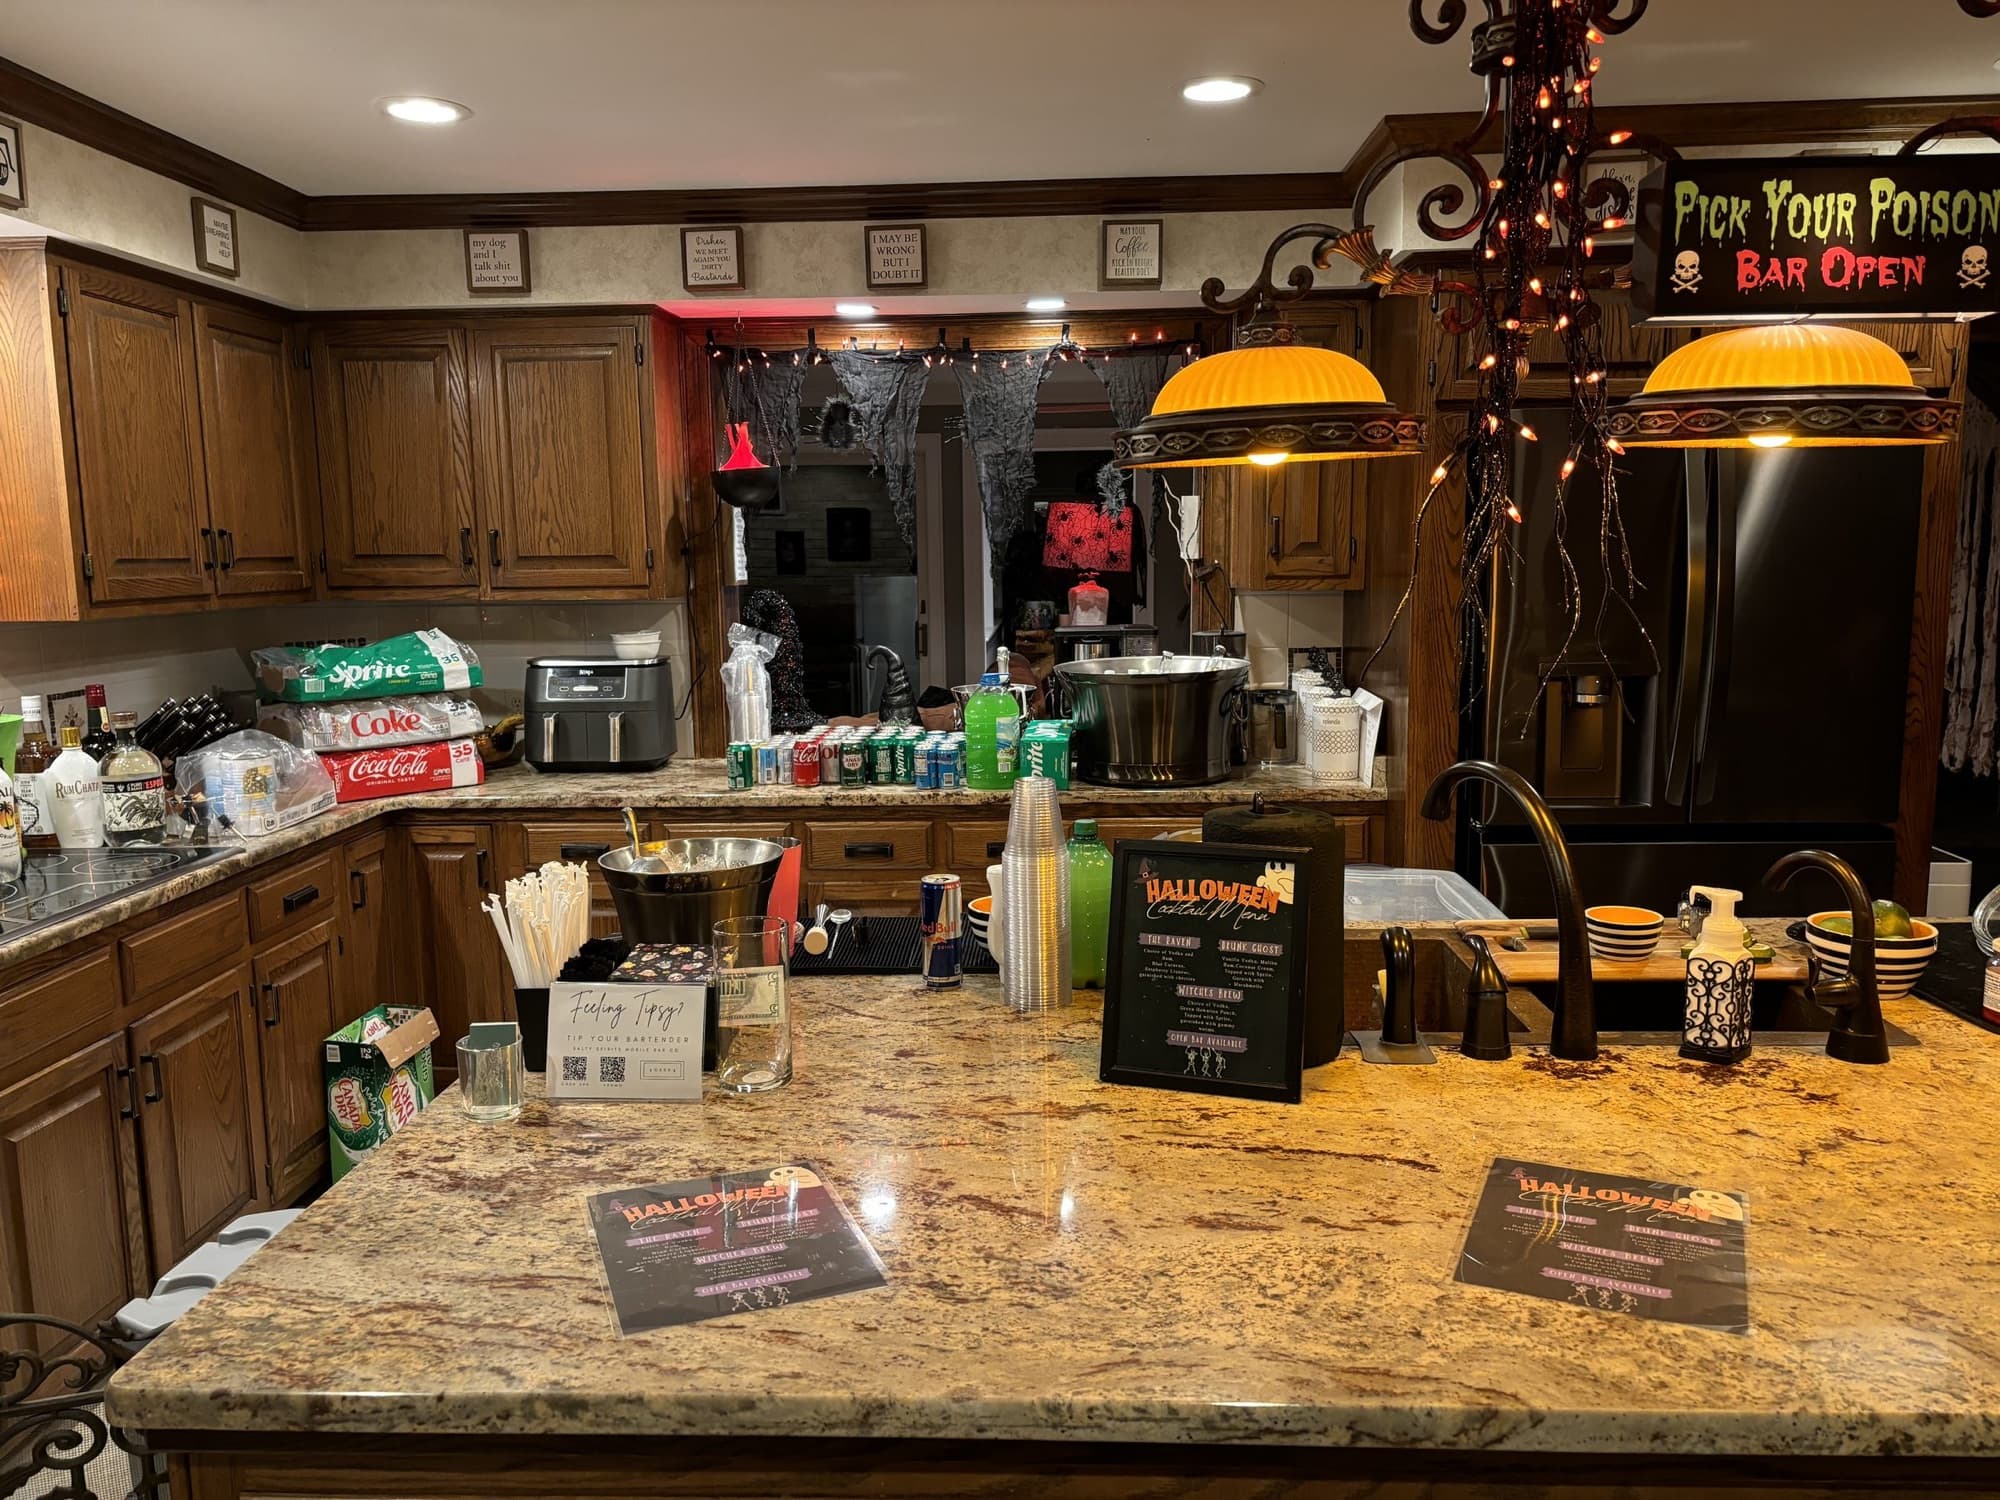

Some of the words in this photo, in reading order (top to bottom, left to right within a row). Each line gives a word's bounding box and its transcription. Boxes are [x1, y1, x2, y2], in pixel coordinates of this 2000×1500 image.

[1675, 180, 1752, 248] PICK
[1762, 178, 1857, 250] YOUR
[1869, 177, 2000, 245] POISON
[473, 240, 486, 249] my
[489, 238, 506, 249] dog
[873, 234, 876, 243] I
[879, 234, 902, 243] MAY
[904, 233, 918, 242] BE
[473, 250, 489, 258] and
[492, 250, 496, 258] I
[876, 246, 915, 255] WRONG
[1115, 235, 1149, 258] Coffee
[475, 261, 491, 270] talk
[494, 261, 511, 270] shit
[883, 257, 904, 267] BUT
[906, 257, 909, 266] I
[873, 270, 908, 279] DOUBT
[910, 269, 920, 278] IT
[1735, 249, 1808, 295] BAR
[1821, 246, 1926, 292] OPEN
[475, 273, 500, 282] about
[502, 275, 519, 285] you
[441, 653, 460, 665] 35
[328, 660, 411, 690] Sprite
[351, 709, 422, 738] Coke
[452, 744, 473, 758] 35
[895, 744, 905, 777] Sprite
[1026, 741, 1044, 777] prite
[366, 779, 396, 787] ORIGINAL
[397, 776, 416, 784] TASTE
[1146, 878, 1280, 915] HALLOWEEN
[1146, 889, 1209, 920] Cocktail
[1207, 895, 1272, 930] Menu
[936, 922, 957, 933] Bull
[1147, 933, 1160, 945] THE
[1166, 935, 1191, 947] RAVEN
[1221, 939, 1247, 952] DRUNK
[1251, 943, 1278, 954] GHOST
[1177, 984, 1214, 998] WITCHES
[1218, 988, 1241, 1000] BREW
[570, 989, 627, 1030] Feeling
[633, 988, 685, 1032] Tipsy?
[1206, 1036, 1242, 1048] AVAILABLE
[362, 1047, 373, 1060] 24
[334, 1095, 349, 1121] DRY
[338, 1077, 363, 1132] CANADA
[622, 1184, 792, 1224] HALLOWEEN
[1520, 1178, 1713, 1222] HALLOWEEN
